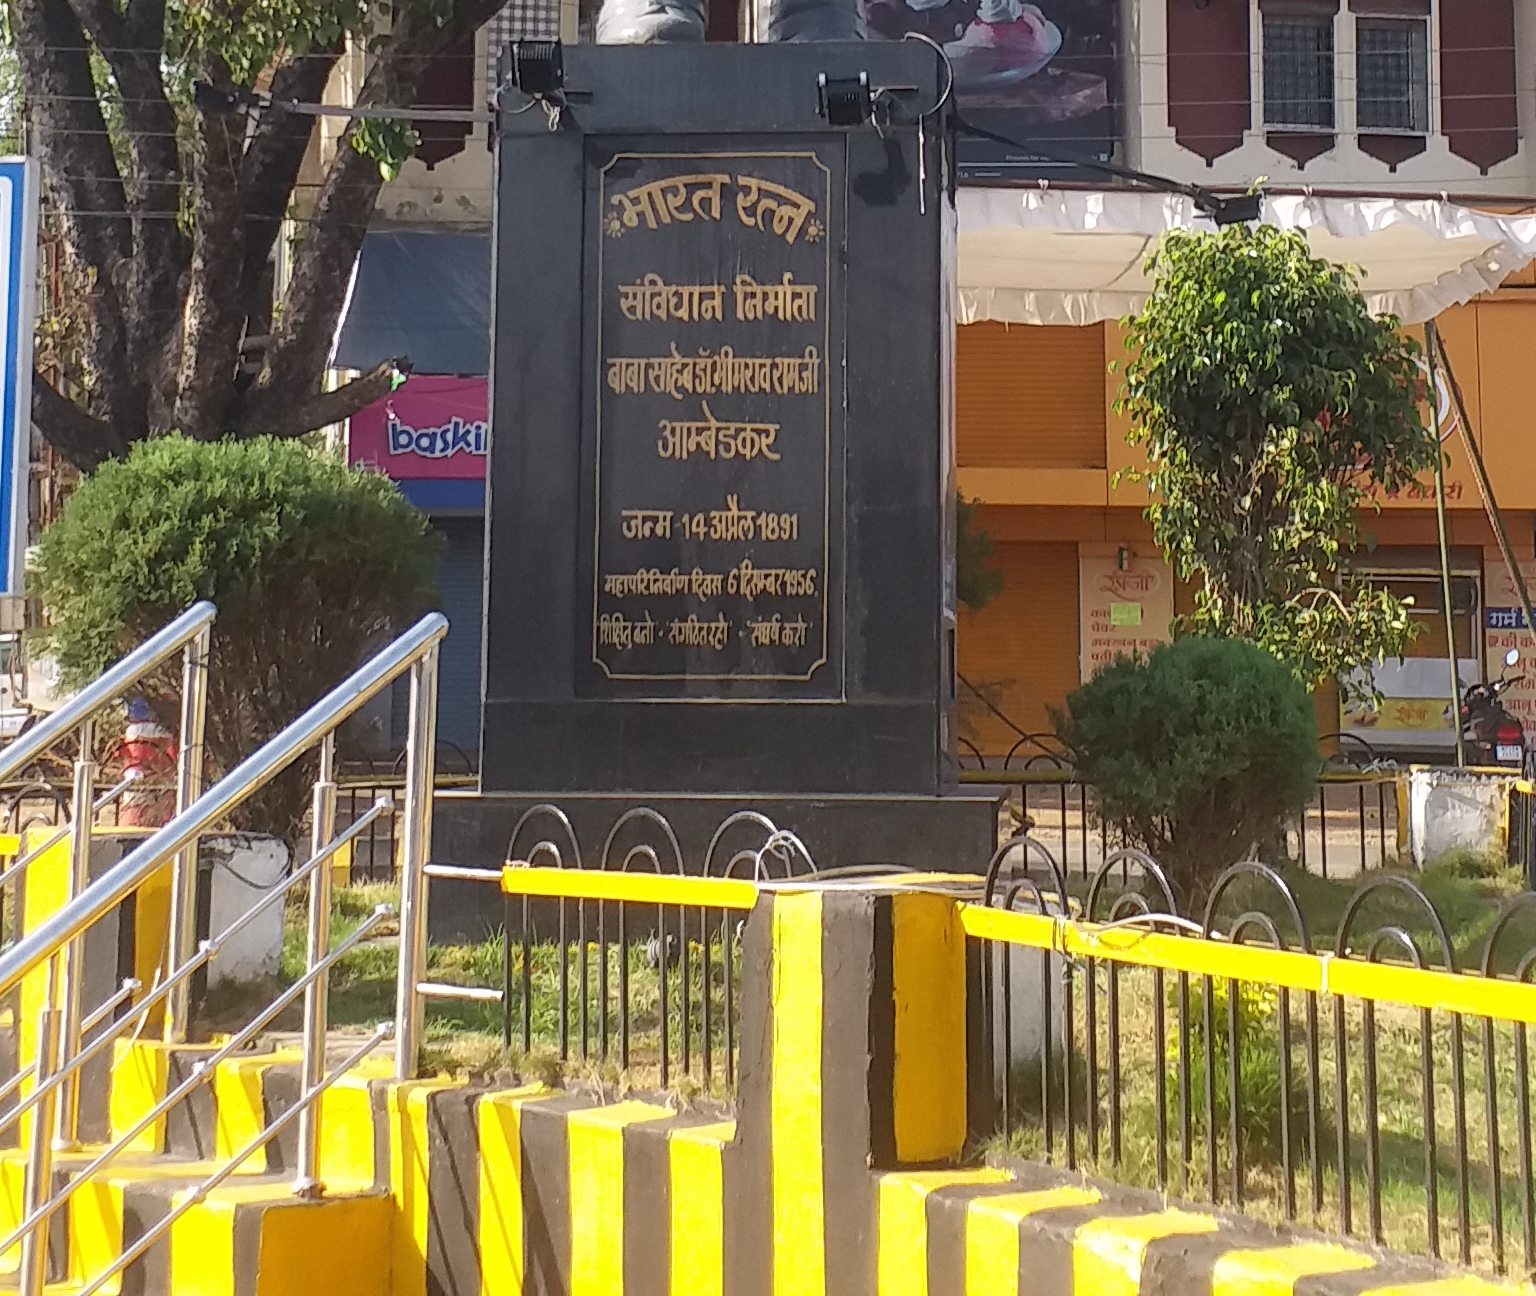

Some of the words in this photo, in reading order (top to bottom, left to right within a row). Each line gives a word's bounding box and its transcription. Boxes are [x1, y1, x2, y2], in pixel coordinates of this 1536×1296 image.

[610, 174, 731, 230] भारत
[736, 174, 816, 245] रत्न
[618, 273, 726, 322] संविधान
[733, 271, 819, 322] निर्माता
[606, 357, 648, 395] बाबा
[648, 341, 695, 400] साहेब
[773, 345, 821, 395] रामजी
[657, 399, 782, 460] आम्बेडकर
[621, 509, 674, 540] जन्म
[757, 512, 799, 541] 1891
[727, 568, 737, 595] 6
